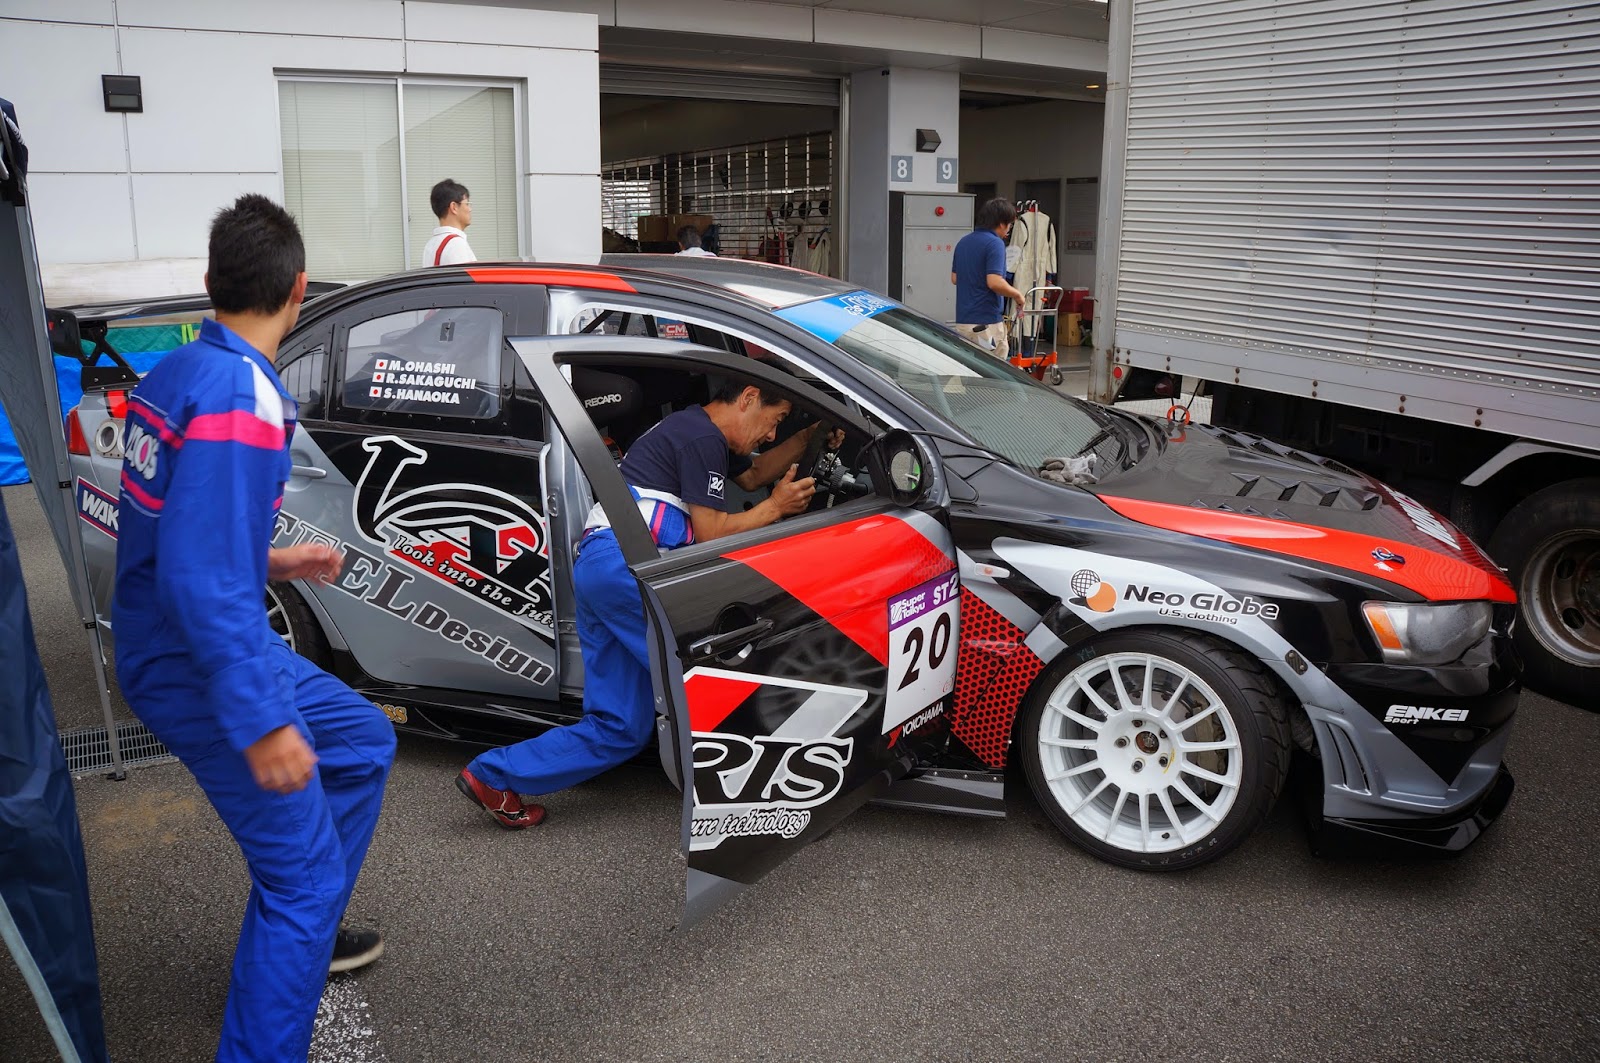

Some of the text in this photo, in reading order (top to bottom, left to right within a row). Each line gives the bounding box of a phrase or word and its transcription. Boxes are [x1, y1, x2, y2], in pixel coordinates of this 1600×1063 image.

[897, 159, 908, 179] 8
[942, 161, 953, 180] 9
[388, 360, 456, 375] M.OHASHI
[386, 373, 477, 390] R.SAKAGUCHI
[383, 388, 461, 405] S.HANAOKA
[584, 393, 622, 409] RECARO
[710, 476, 724, 492] 20
[393, 534, 436, 567] look
[438, 561, 477, 588] into
[481, 584, 512, 606] the
[901, 592, 926, 608] Super
[1123, 583, 1280, 620] Neo Globe
[902, 602, 926, 619] Taikyu
[1158, 607, 1239, 626] U.S. clothing
[413, 601, 555, 687] Design
[897, 612, 951, 692] 20
[373, 702, 408, 724] SS
[902, 701, 944, 738] YOKOHAMA
[1383, 716, 1420, 725] Sport
[1385, 704, 1470, 722] ENKEI
[720, 807, 811, 839] technology
